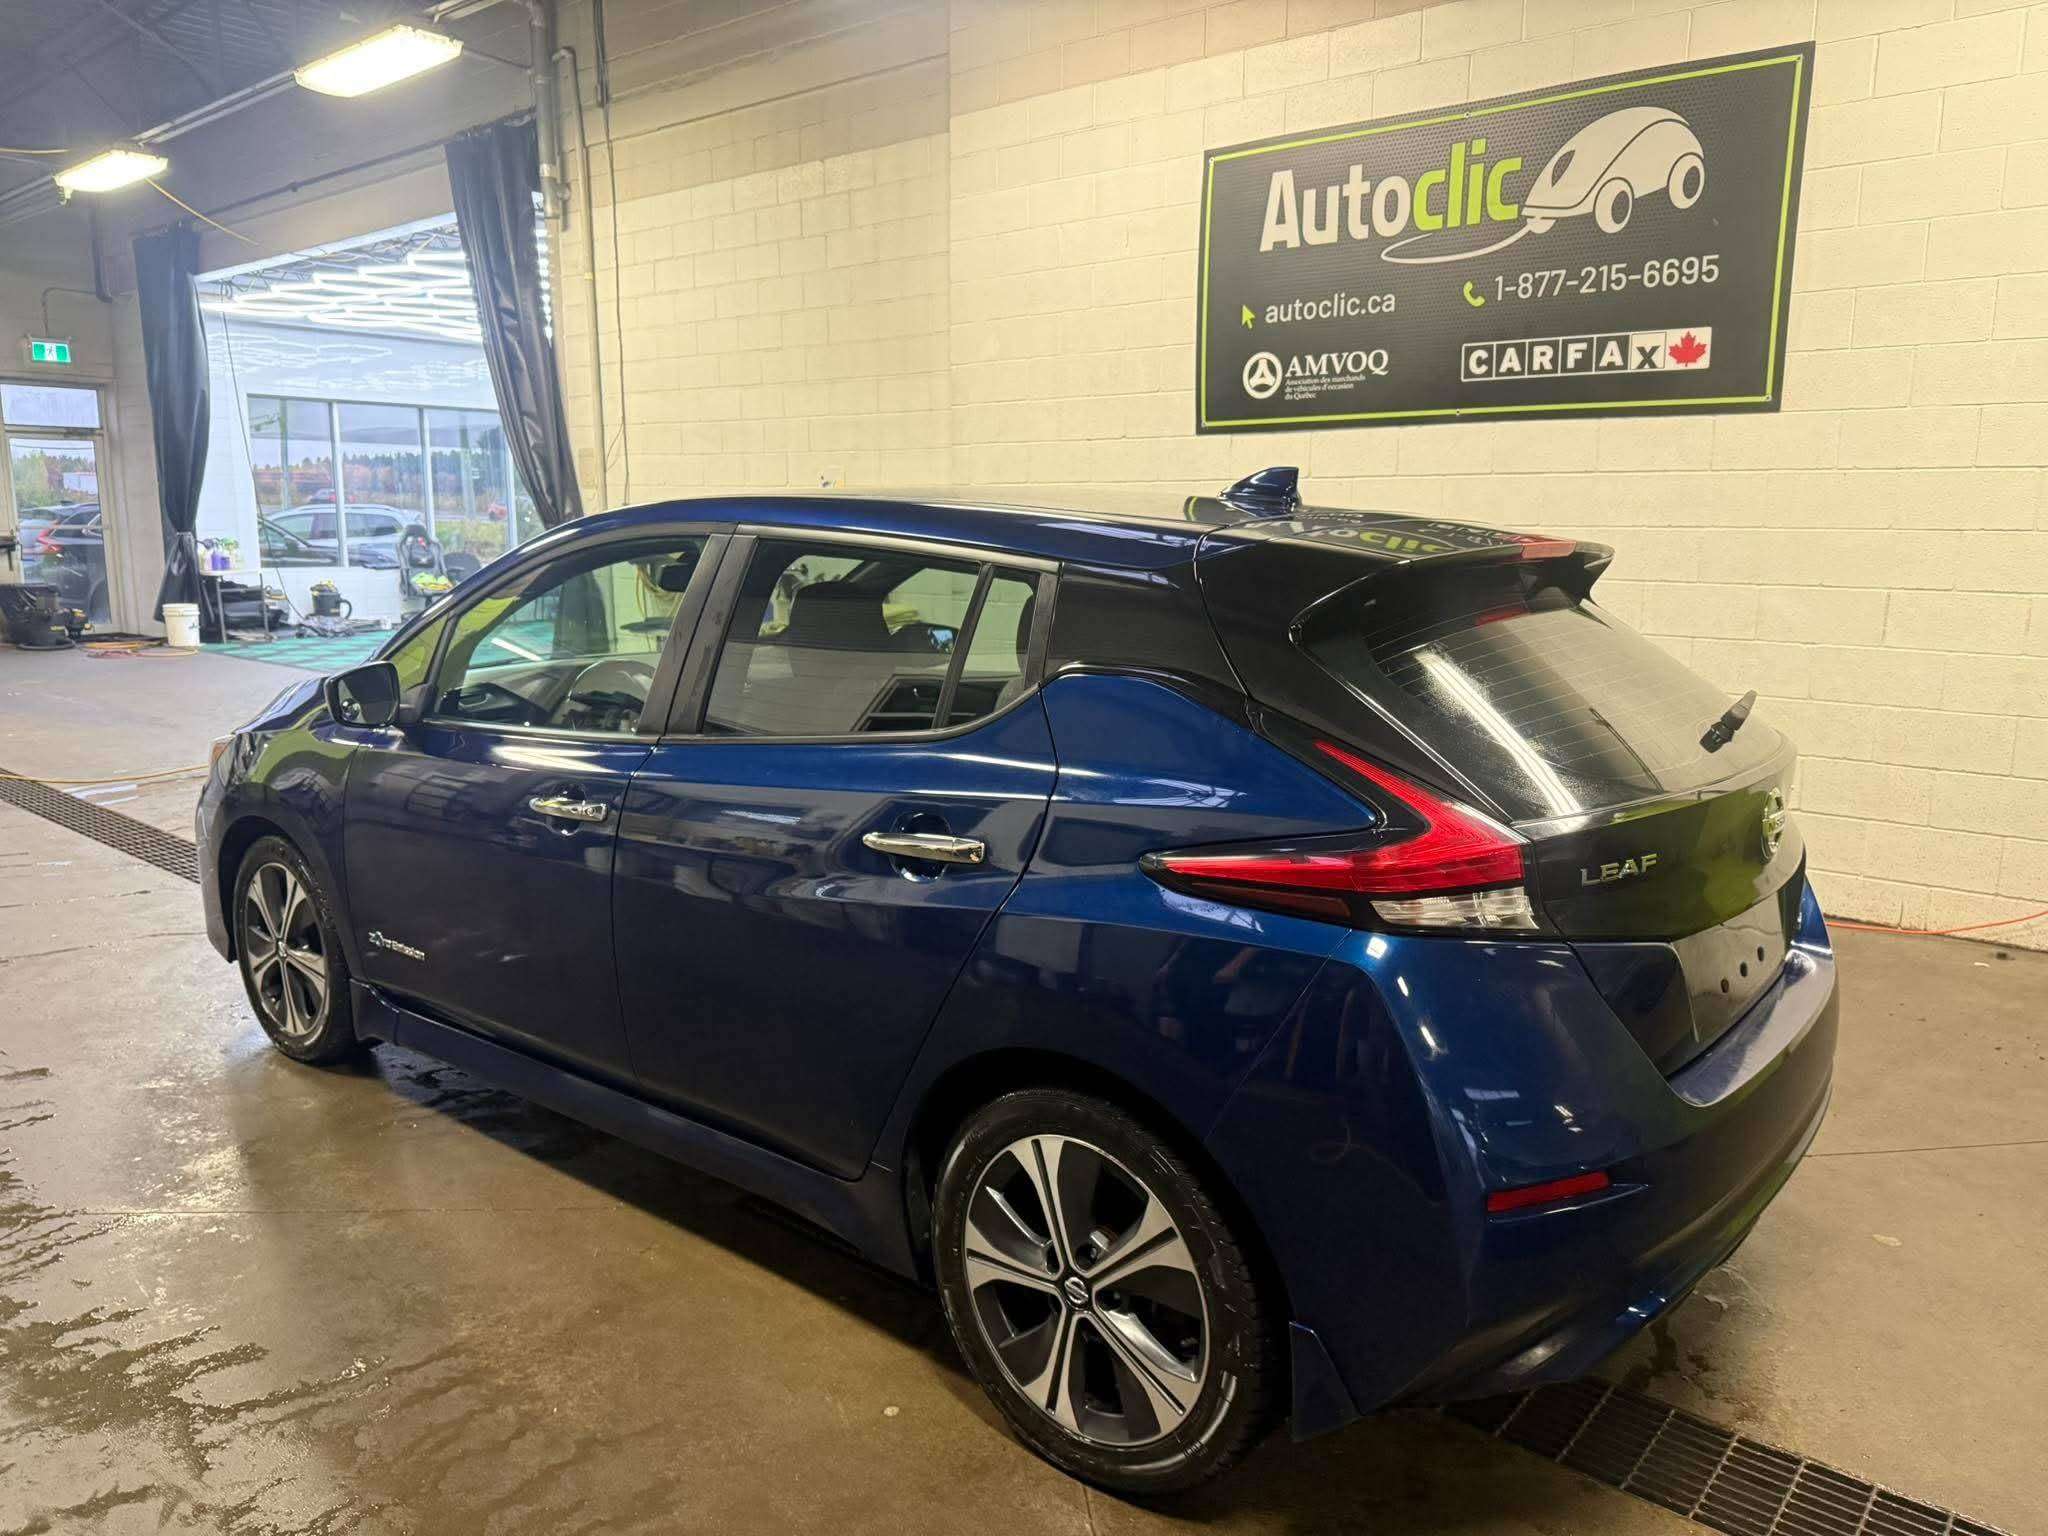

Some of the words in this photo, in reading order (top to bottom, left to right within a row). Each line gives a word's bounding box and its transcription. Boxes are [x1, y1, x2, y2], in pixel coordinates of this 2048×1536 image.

[1259, 138, 1522, 252] Autoclic
[1494, 254, 1720, 301] 1-877-215-6695
[1265, 292, 1396, 324] autoclic.ca
[1285, 349, 1390, 377] AMVOQ
[1468, 340, 1661, 376] CARFAX
[1580, 853, 1658, 889] LEAF
